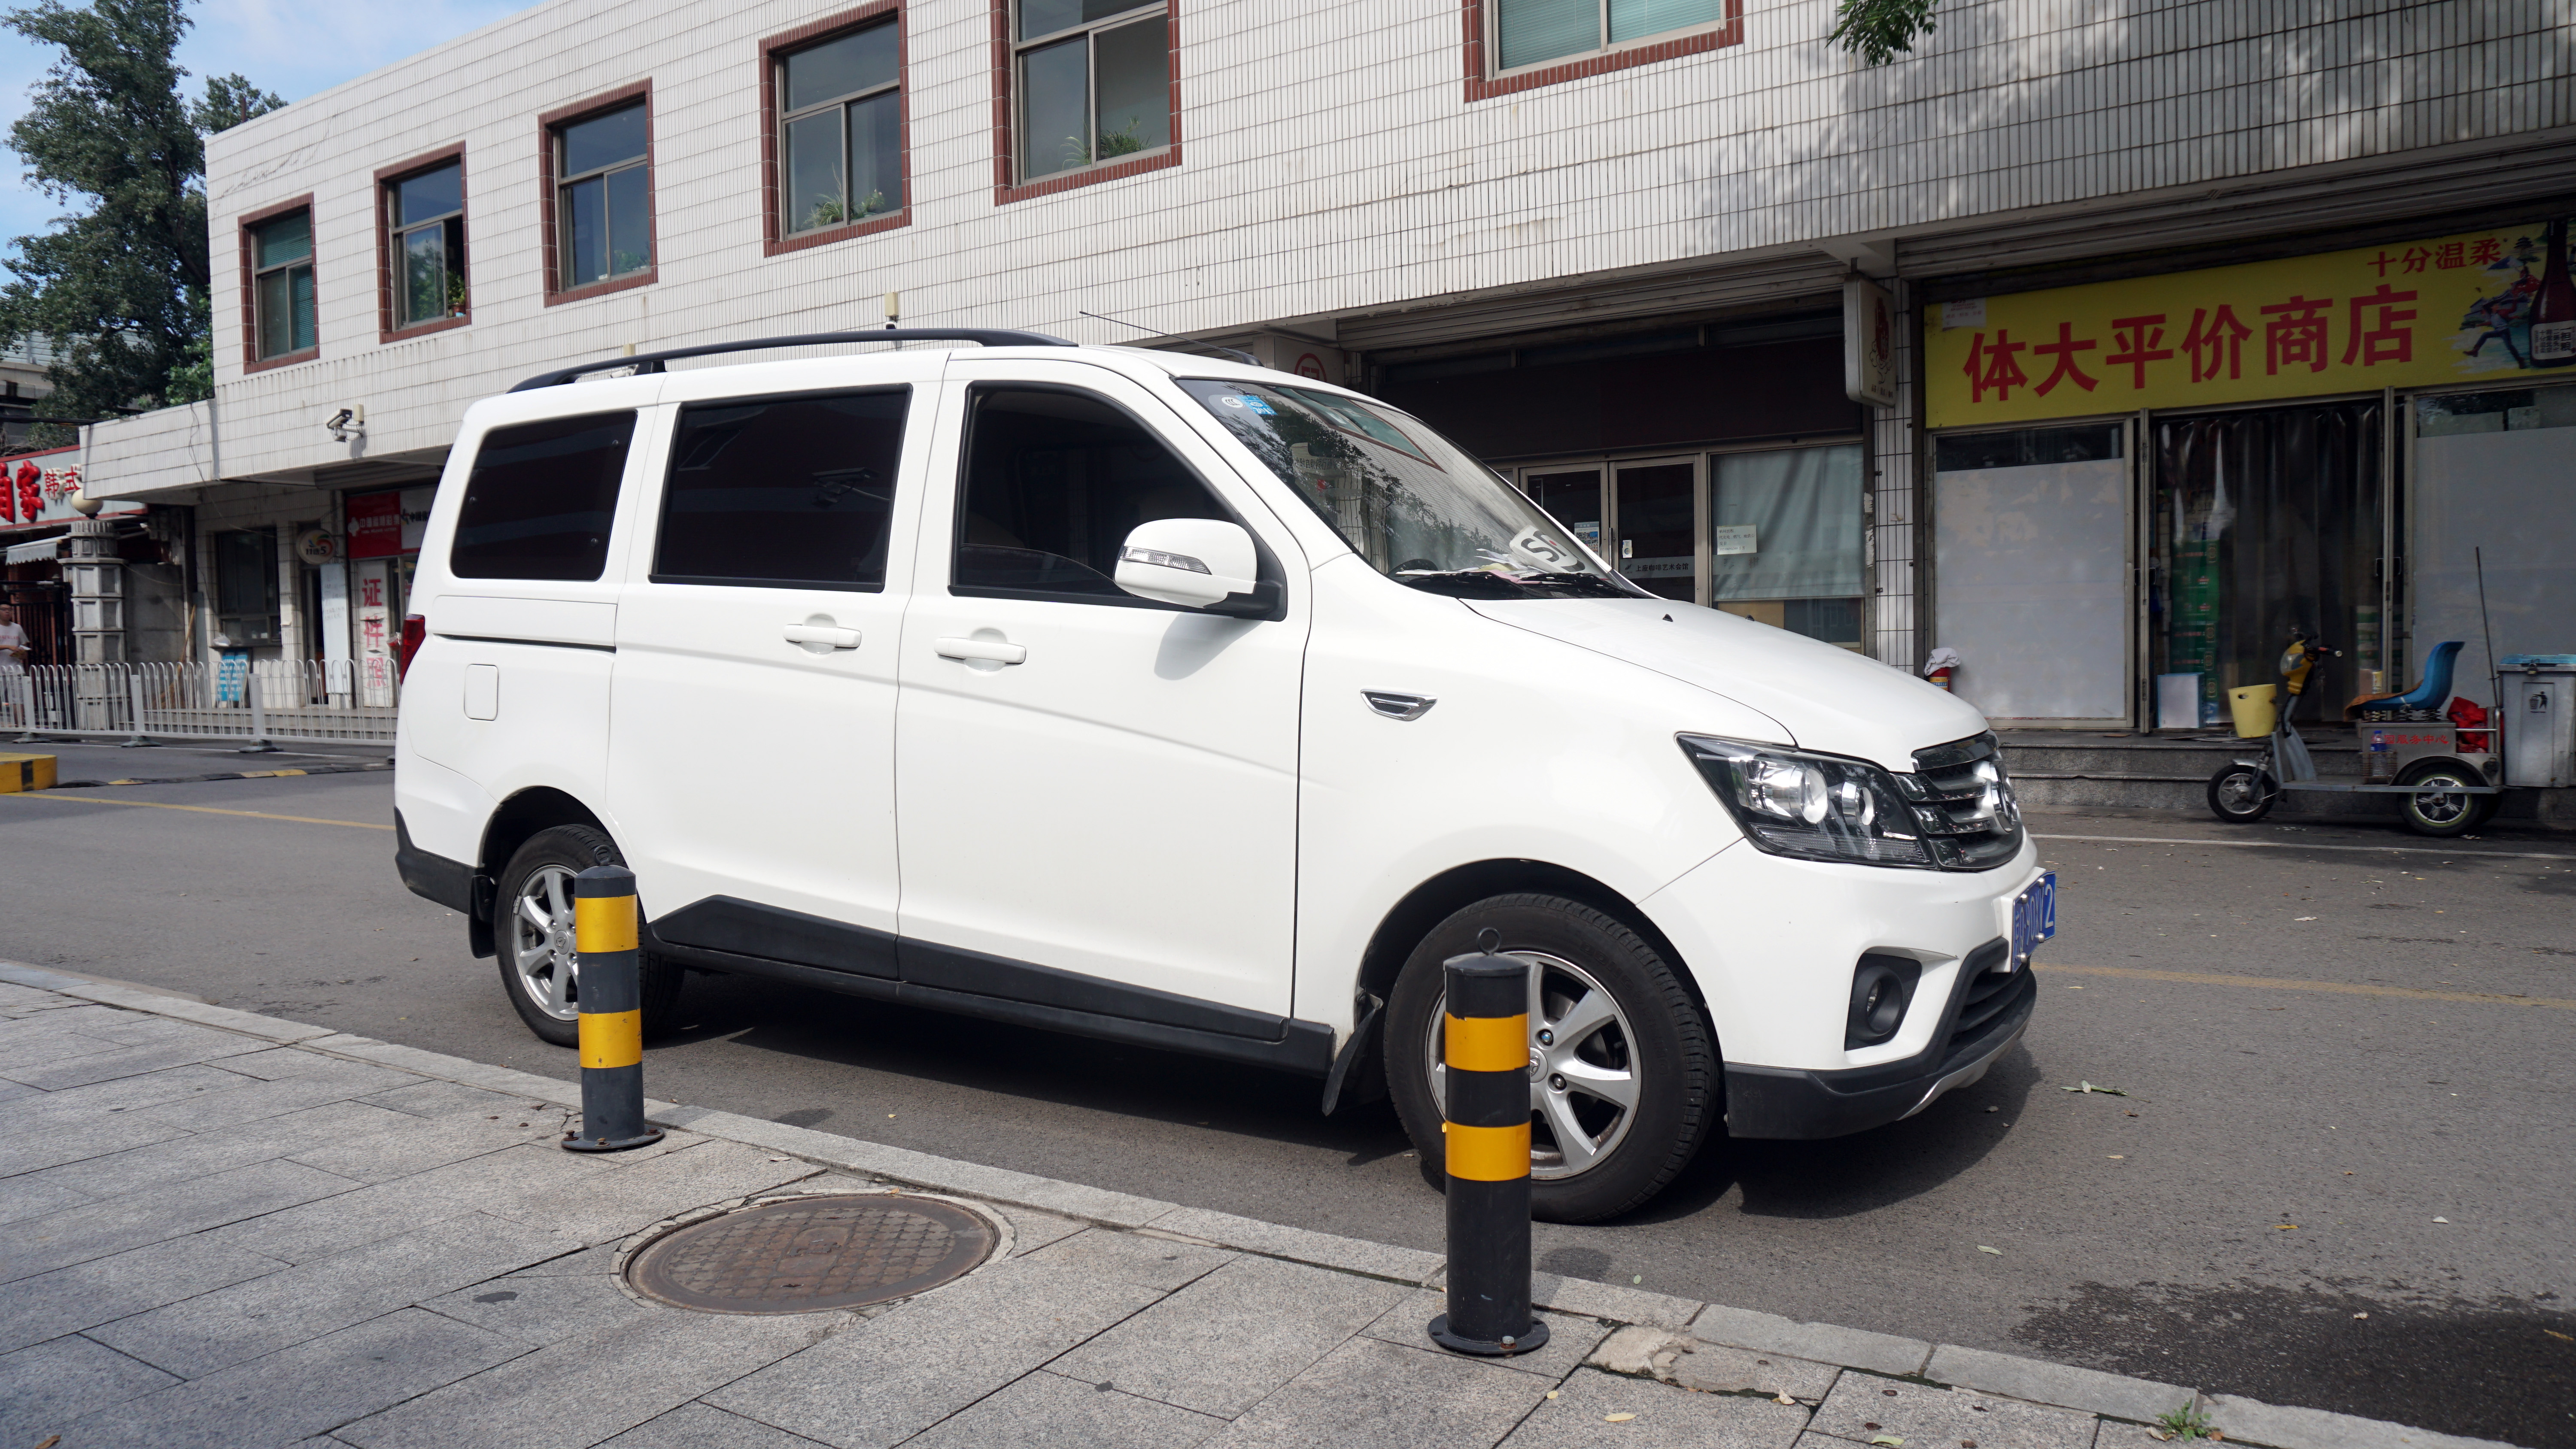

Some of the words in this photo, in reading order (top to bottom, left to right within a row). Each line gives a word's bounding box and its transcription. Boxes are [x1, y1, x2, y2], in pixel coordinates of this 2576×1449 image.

[2367, 237, 2501, 278] 十分温柔
[1962, 284, 2418, 403] 体大平价商店
[1636, 563, 1689, 572] 上座咖啡艺术会馆
[2371, 734, 2449, 745] 园服务中心
